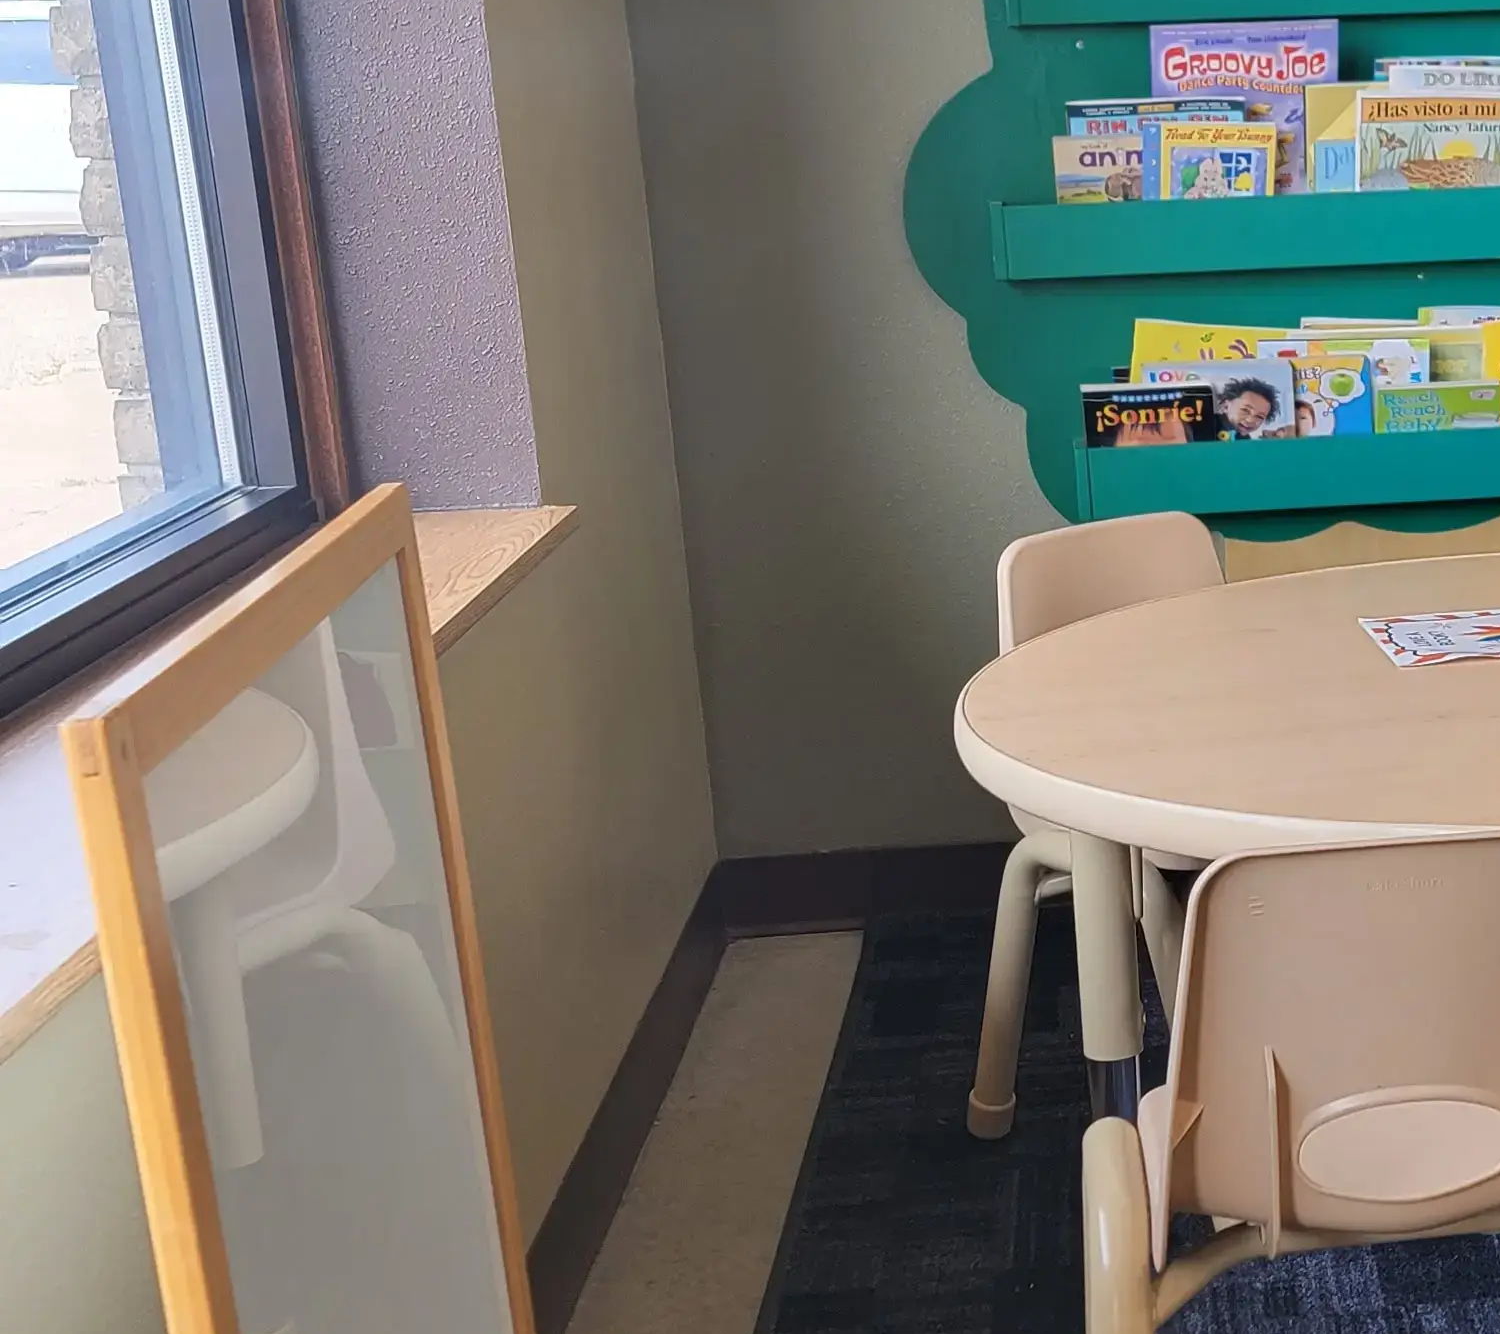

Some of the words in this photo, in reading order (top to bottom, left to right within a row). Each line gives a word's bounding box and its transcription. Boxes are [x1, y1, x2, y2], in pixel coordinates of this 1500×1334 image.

[1177, 76, 1215, 93] Dance
[1216, 75, 1250, 90] Party
[1423, 72, 1455, 87] DO
[1368, 101, 1408, 122] ¿Has
[1414, 101, 1454, 117] visto
[1459, 104, 1469, 116] a
[1475, 103, 1497, 116] mi
[1423, 123, 1460, 133] Nancy
[1096, 400, 1203, 433] ¡Sonríe!
